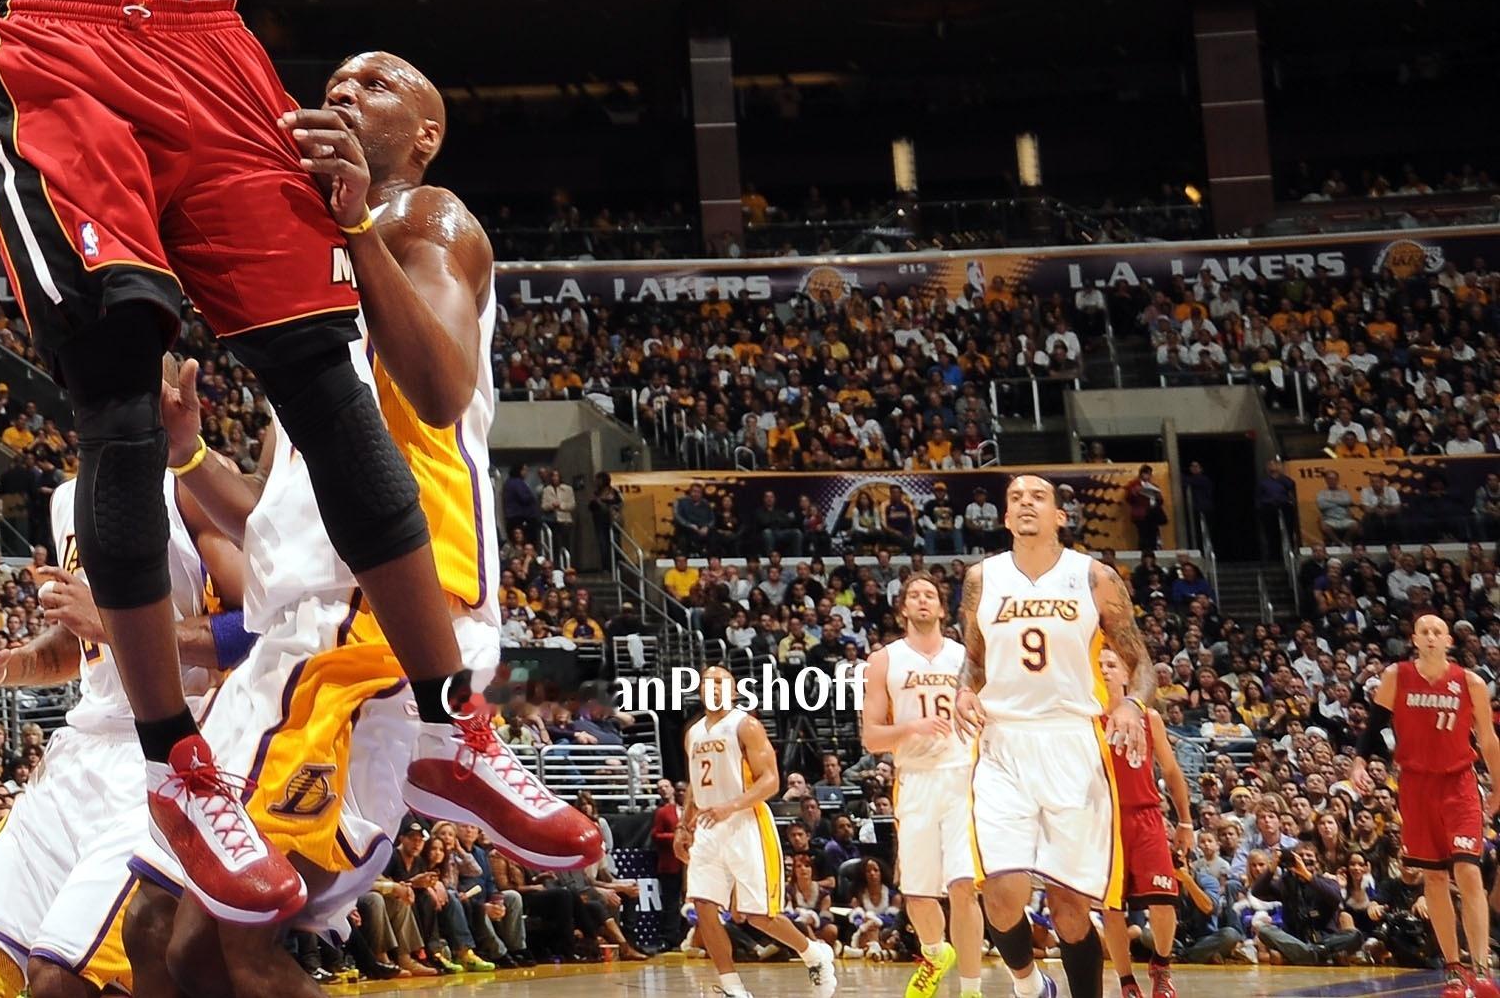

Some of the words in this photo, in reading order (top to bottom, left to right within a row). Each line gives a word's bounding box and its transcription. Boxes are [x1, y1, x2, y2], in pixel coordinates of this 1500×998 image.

[331, 246, 358, 290] M
[898, 263, 927, 275] 215
[1171, 251, 1346, 284] LAKERS
[519, 277, 591, 303] L.A.
[613, 275, 772, 302] LAKERS
[1299, 467, 1325, 479] 115
[991, 595, 1078, 625] LAKERS
[1021, 627, 1047, 672] 9
[919, 694, 951, 721] 16
[1406, 693, 1460, 711] MIAMI
[1436, 711, 1457, 732] 11
[701, 758, 713, 788] 2
